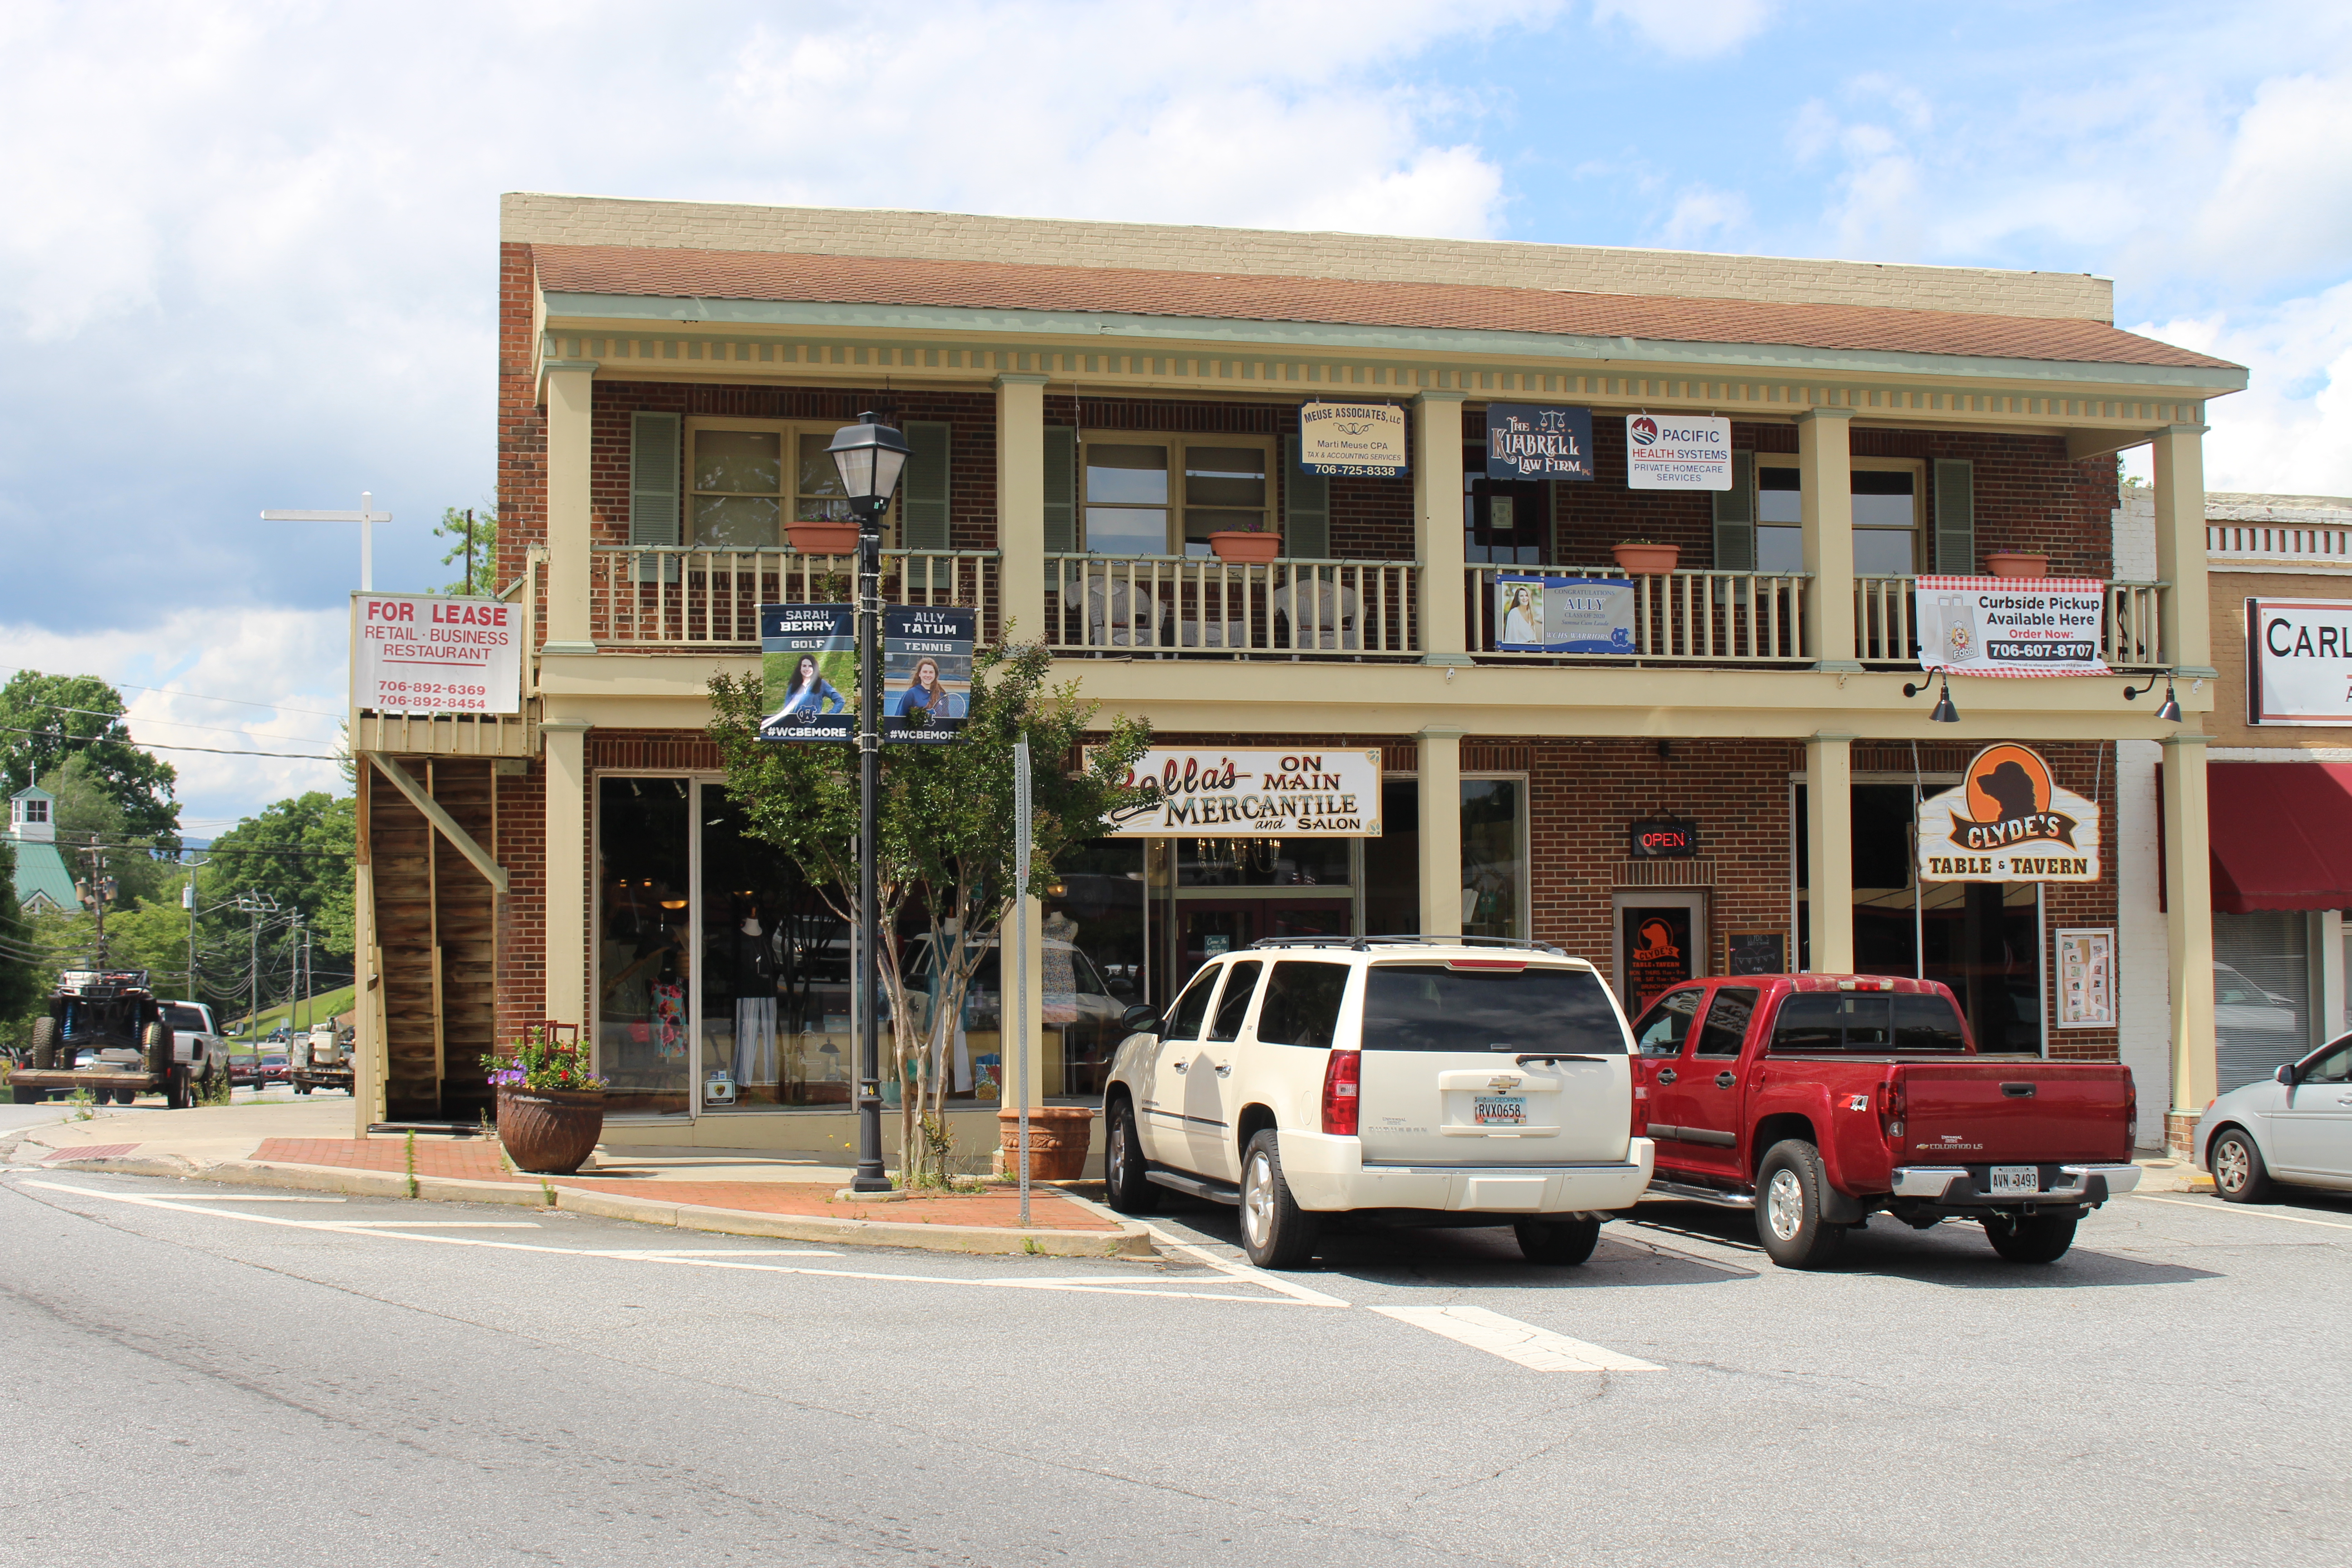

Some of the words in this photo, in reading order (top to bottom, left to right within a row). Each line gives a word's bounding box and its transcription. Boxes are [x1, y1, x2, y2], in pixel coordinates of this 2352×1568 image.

[1304, 409, 1332, 423] MEUSE
[1336, 408, 1388, 423] ASSOCIATES,
[1390, 415, 1401, 424] LLC
[1506, 416, 1530, 433] THE
[1662, 429, 1720, 442] PACIFIC
[1341, 441, 1368, 449] Meuse
[1370, 442, 1388, 450] CPA
[1490, 428, 1580, 465] KIMBRELL
[1632, 449, 1674, 458] HEALTH
[1677, 450, 1727, 460] SYSTEMS
[1315, 465, 1395, 476] 706-725-8338
[1518, 456, 1543, 475] LAW
[1544, 457, 1581, 472] FIRM
[1634, 464, 1670, 472] PRIVATE
[1673, 465, 1723, 473] HOMECARE
[1564, 598, 1606, 611] ALLY
[1979, 596, 2044, 610] Curbside
[2049, 597, 2100, 612] Pickup
[368, 602, 414, 622] FOR
[432, 604, 507, 626] LEASE
[786, 610, 829, 620] SARAH
[914, 612, 945, 623] ALLY
[1986, 612, 2054, 626] Available
[2059, 614, 2095, 626] Here
[780, 620, 836, 632] BERRY
[903, 623, 957, 635] TATUM
[365, 625, 418, 641] RETAIL
[430, 628, 509, 645] BUSINESS
[2009, 629, 2041, 639] Order
[2045, 629, 2074, 639] Now:
[2266, 617, 2352, 658] CARL
[791, 639, 825, 649] GOLF
[905, 642, 952, 652] TENNIS
[1990, 644, 2092, 657] 706-607-8707
[384, 644, 492, 660] RESTAURANT
[1953, 648, 1974, 659] FOOD
[378, 681, 485, 696] 706-892-6369
[378, 695, 485, 709] 706-892-8454
[767, 727, 847, 737] #WCBEMORE
[1281, 756, 1321, 771] ON
[1263, 774, 1340, 790] MAIN
[1165, 795, 1357, 826] MERCANTILE
[1255, 818, 1286, 830] and
[1298, 818, 1360, 829] SALON
[1967, 814, 2061, 848] CLYDE'S
[1642, 833, 1685, 847] OPEN
[1929, 858, 1991, 874] TABLE
[1998, 860, 2005, 870] &
[2010, 858, 2088, 874] TAVERN
[1639, 947, 1674, 960] CLYDE'S
[869, 1085, 874, 1095] 4
[1838, 1093, 1869, 1107] Z71
[1479, 1103, 1520, 1117] RVX0658
[1994, 1174, 2008, 1187] AVN
[2015, 1174, 2036, 1186] 3493
